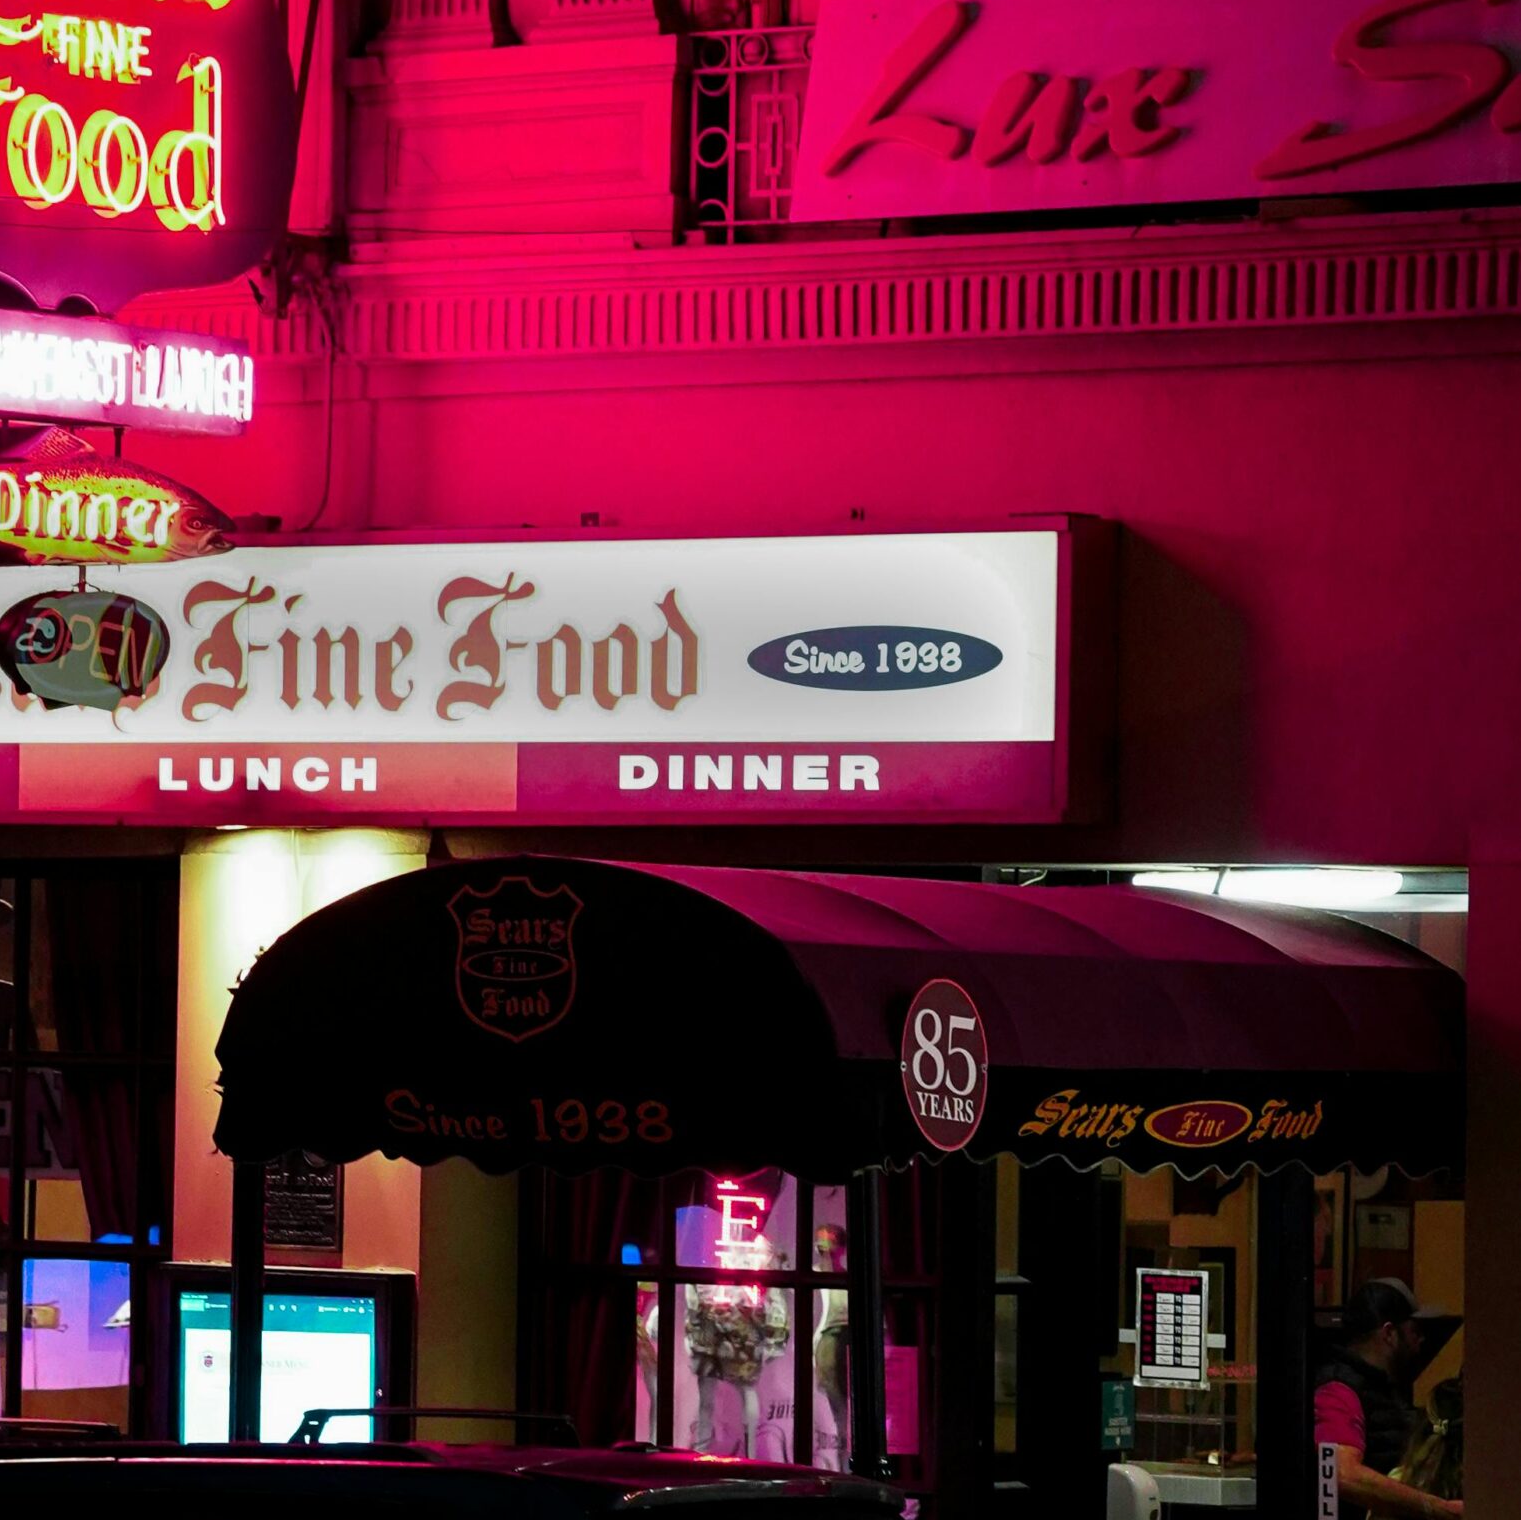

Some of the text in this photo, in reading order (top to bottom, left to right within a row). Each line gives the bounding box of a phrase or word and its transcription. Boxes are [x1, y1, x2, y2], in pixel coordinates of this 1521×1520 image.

[42, 12, 154, 85] FINE
[823, 0, 1193, 178] Lux
[30, 597, 159, 690] OPEN
[182, 575, 415, 723] Fine
[436, 570, 699, 723] Food
[783, 638, 963, 675] Since 1938
[158, 756, 378, 792] LUNCH
[618, 754, 881, 791] DINNER
[463, 908, 566, 951] Sears
[491, 955, 540, 976] Fine
[480, 986, 552, 1019] Food
[912, 1007, 978, 1096] 85
[383, 1088, 676, 1145] Since 1938
[916, 1090, 975, 1125] YEARS
[1018, 1088, 1324, 1149] Sears Fine Food
[1322, 1446, 1334, 1517] PULL
